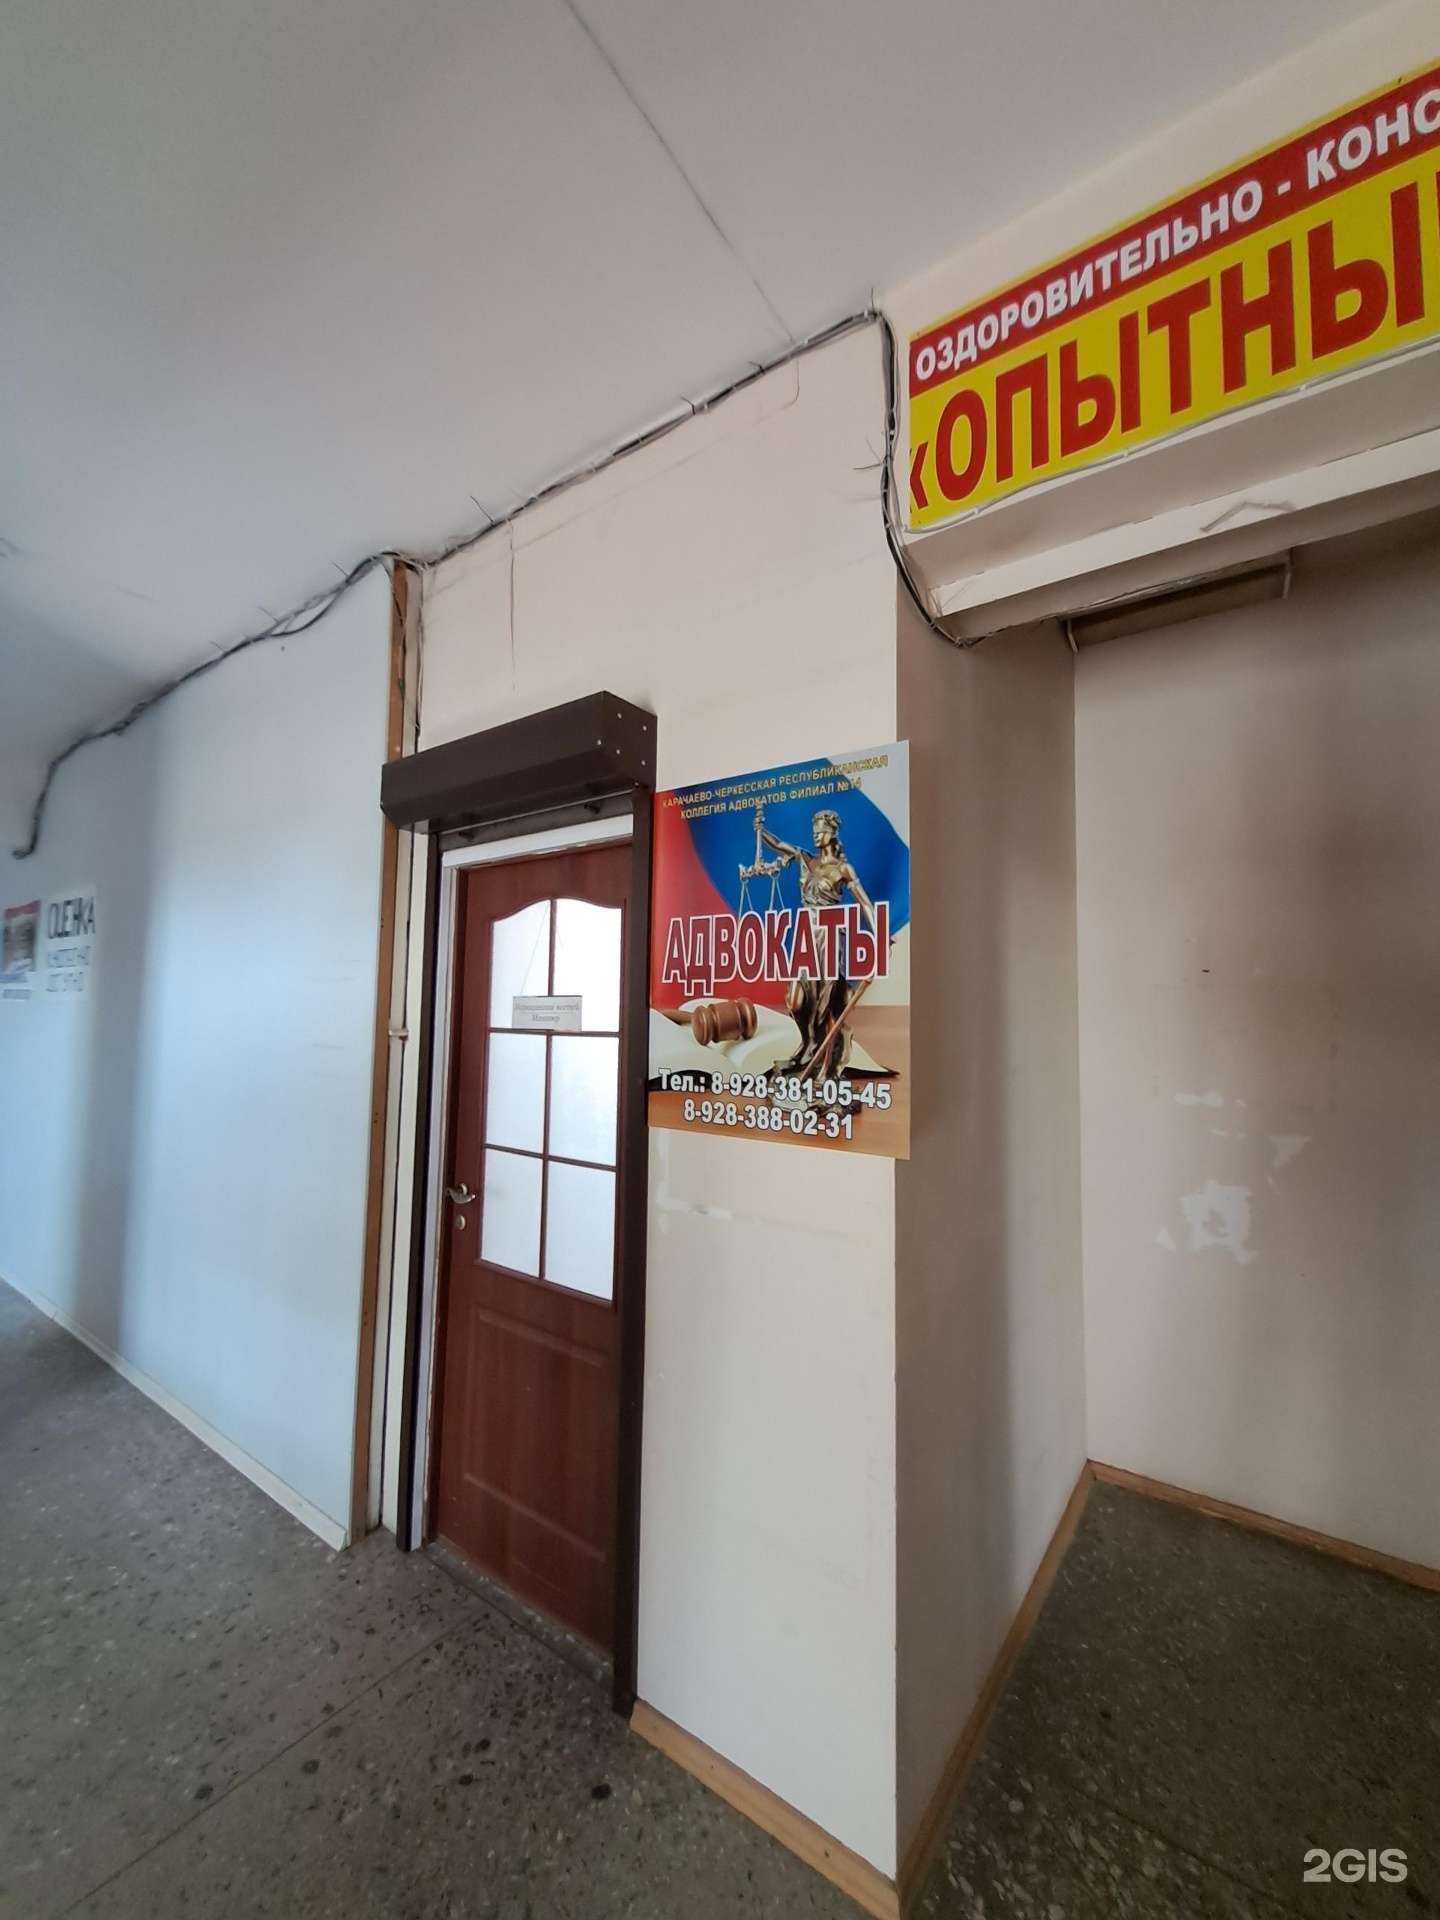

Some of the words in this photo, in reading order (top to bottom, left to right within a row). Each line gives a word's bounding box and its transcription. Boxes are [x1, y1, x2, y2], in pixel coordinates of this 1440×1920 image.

[916, 180, 1263, 381] ОЗДОРОВИТЕЛЬНО
[910, 171, 1440, 510] «ОПЫТНЫ
[662, 777, 776, 809] КАРАЧАЕВО-ЧЕРКЕССКАЯ
[680, 801, 726, 819] КОЛЛЕГИЯ
[728, 791, 786, 812] АДВОКАТОВ
[789, 782, 834, 799] ФИЛИАЛ
[662, 900, 890, 996] АДВОКАТЫ
[658, 1067, 706, 1093] Тел.:
[711, 1072, 892, 1110] 8-928-381-05-45
[683, 1098, 853, 1140] 8-928-388-02-31
